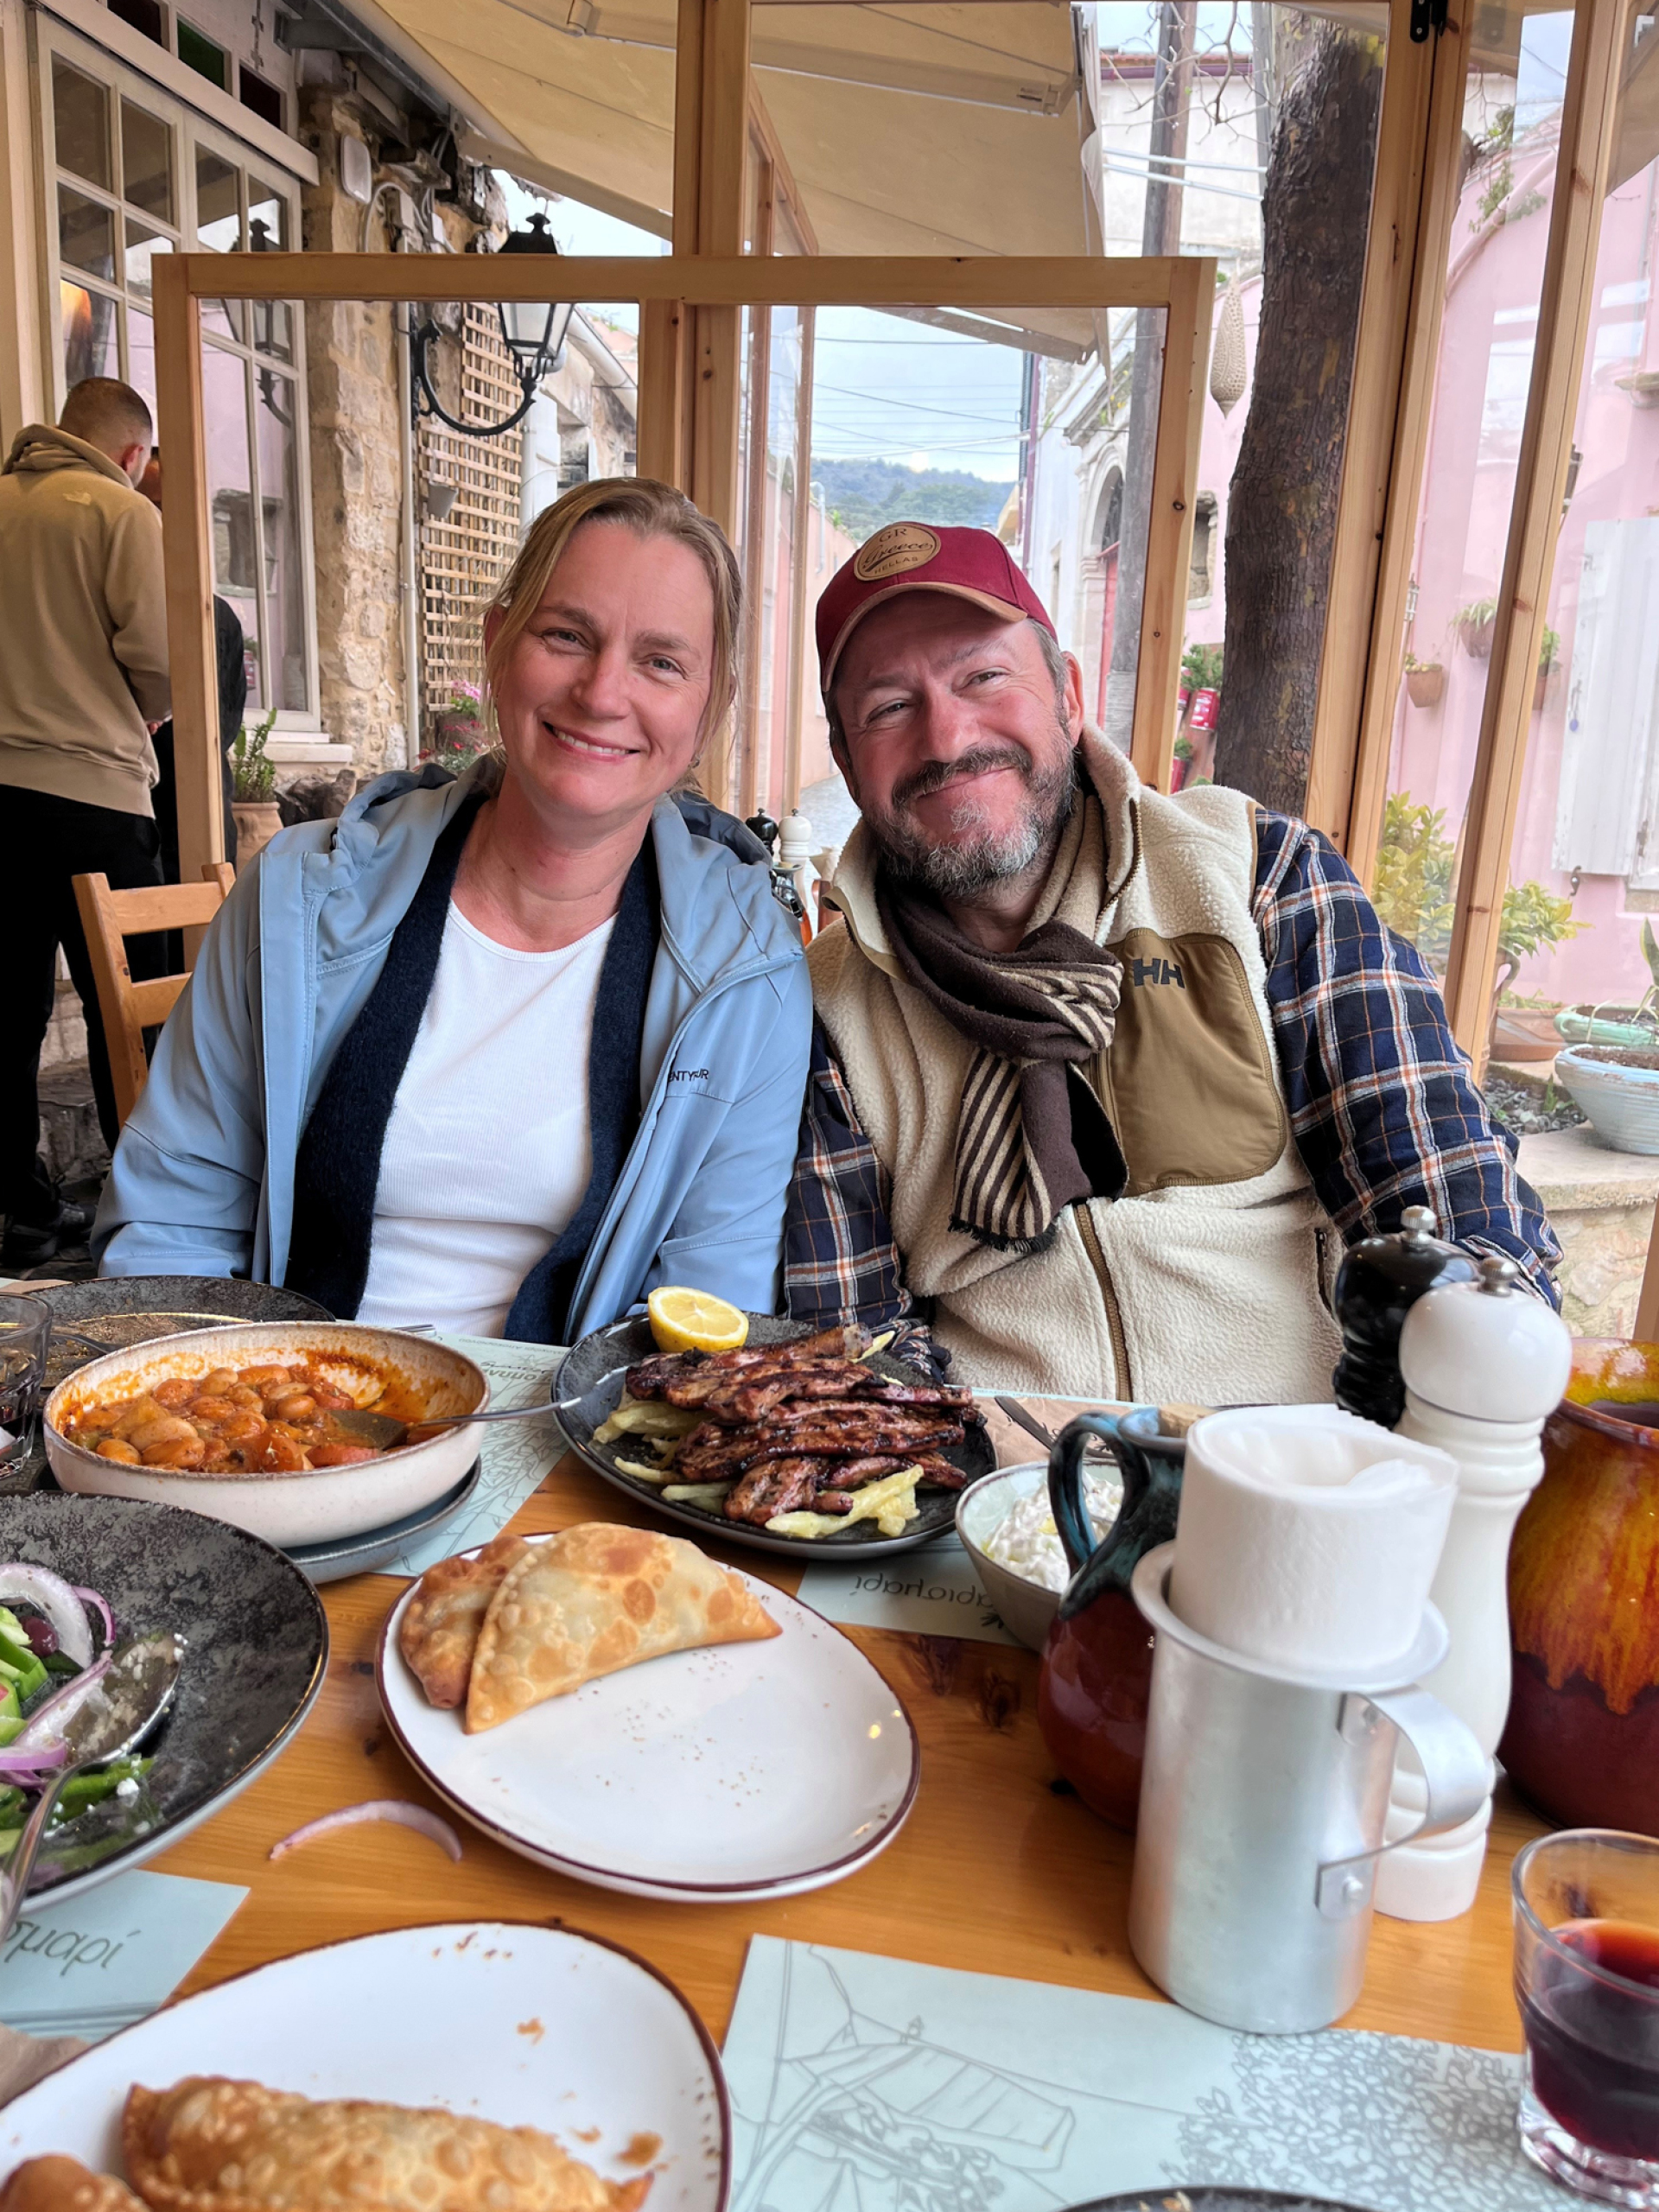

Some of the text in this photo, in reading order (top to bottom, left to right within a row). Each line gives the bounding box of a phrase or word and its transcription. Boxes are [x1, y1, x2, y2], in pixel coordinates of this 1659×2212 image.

[879, 528, 907, 543] GR
[862, 542, 933, 569] Greece
[874, 556, 918, 575] HELLAS
[1133, 957, 1185, 989] HH
